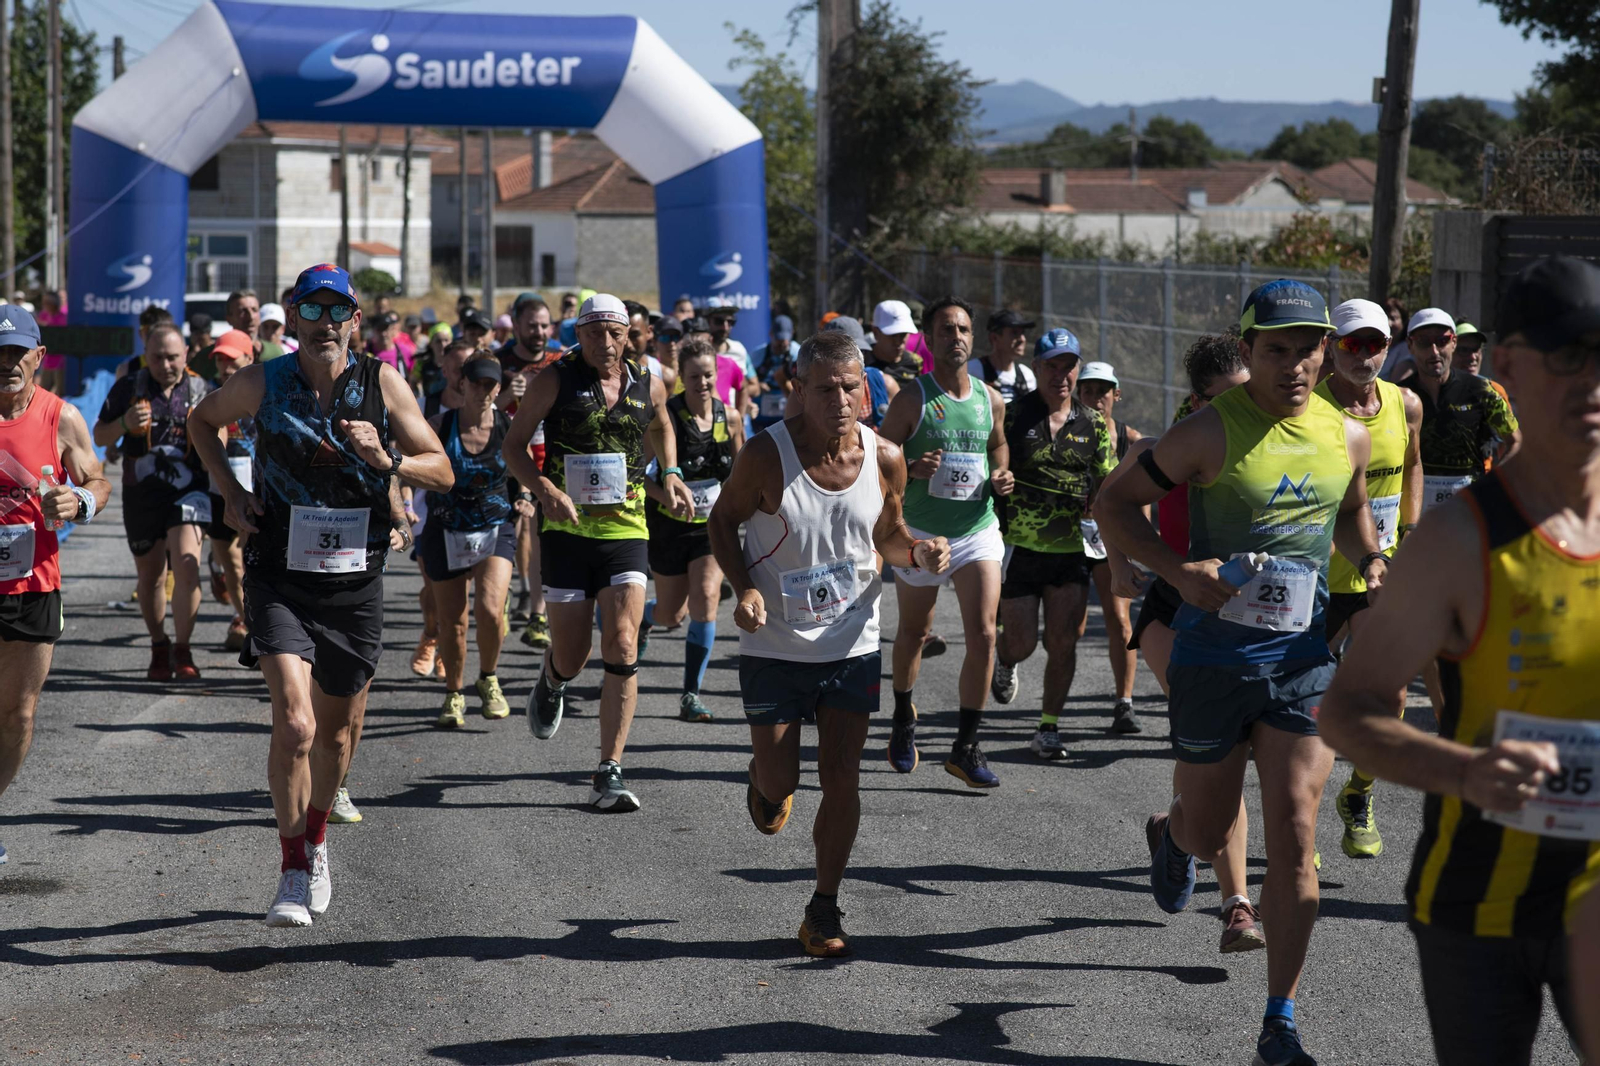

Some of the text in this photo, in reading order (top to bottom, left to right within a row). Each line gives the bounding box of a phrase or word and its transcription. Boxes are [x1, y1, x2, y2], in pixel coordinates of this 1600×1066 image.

[394, 51, 582, 89] Saudeter
[1276, 298, 1314, 308] FRACTEL
[927, 429, 990, 440] SAN MIGUE
[590, 473, 600, 486] 8
[951, 470, 970, 483] 36
[694, 495, 709, 507] 94
[312, 514, 327, 522] Trail
[1249, 524, 1327, 536] ARENTEIRO TRAIL
[318, 533, 342, 549] 31
[800, 573, 814, 582] Trail
[816, 587, 828, 603] 9
[1258, 584, 1288, 604] 23
[1545, 766, 1593, 796] 85
